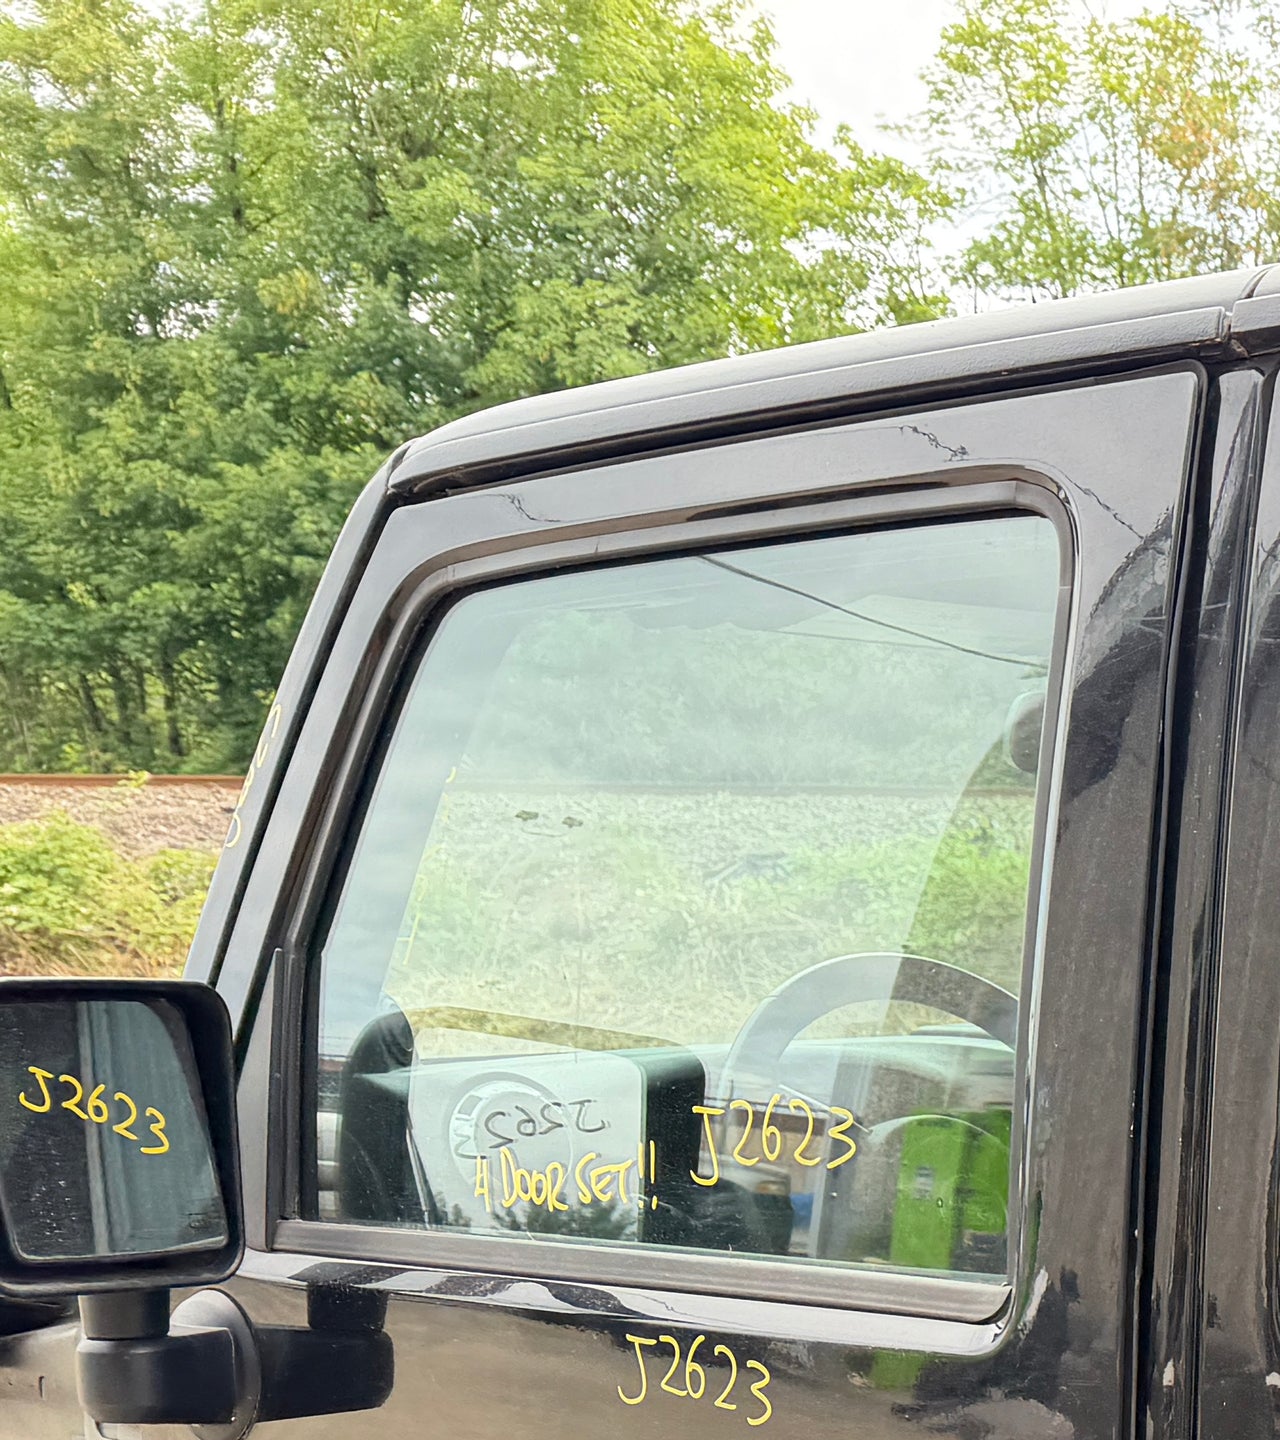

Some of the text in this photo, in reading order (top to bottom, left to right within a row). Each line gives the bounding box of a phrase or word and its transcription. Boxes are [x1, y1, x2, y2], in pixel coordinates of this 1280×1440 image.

[19, 1067, 170, 1155] J2623
[690, 1094, 856, 1186] J2623
[618, 1334, 773, 1426] J2623
